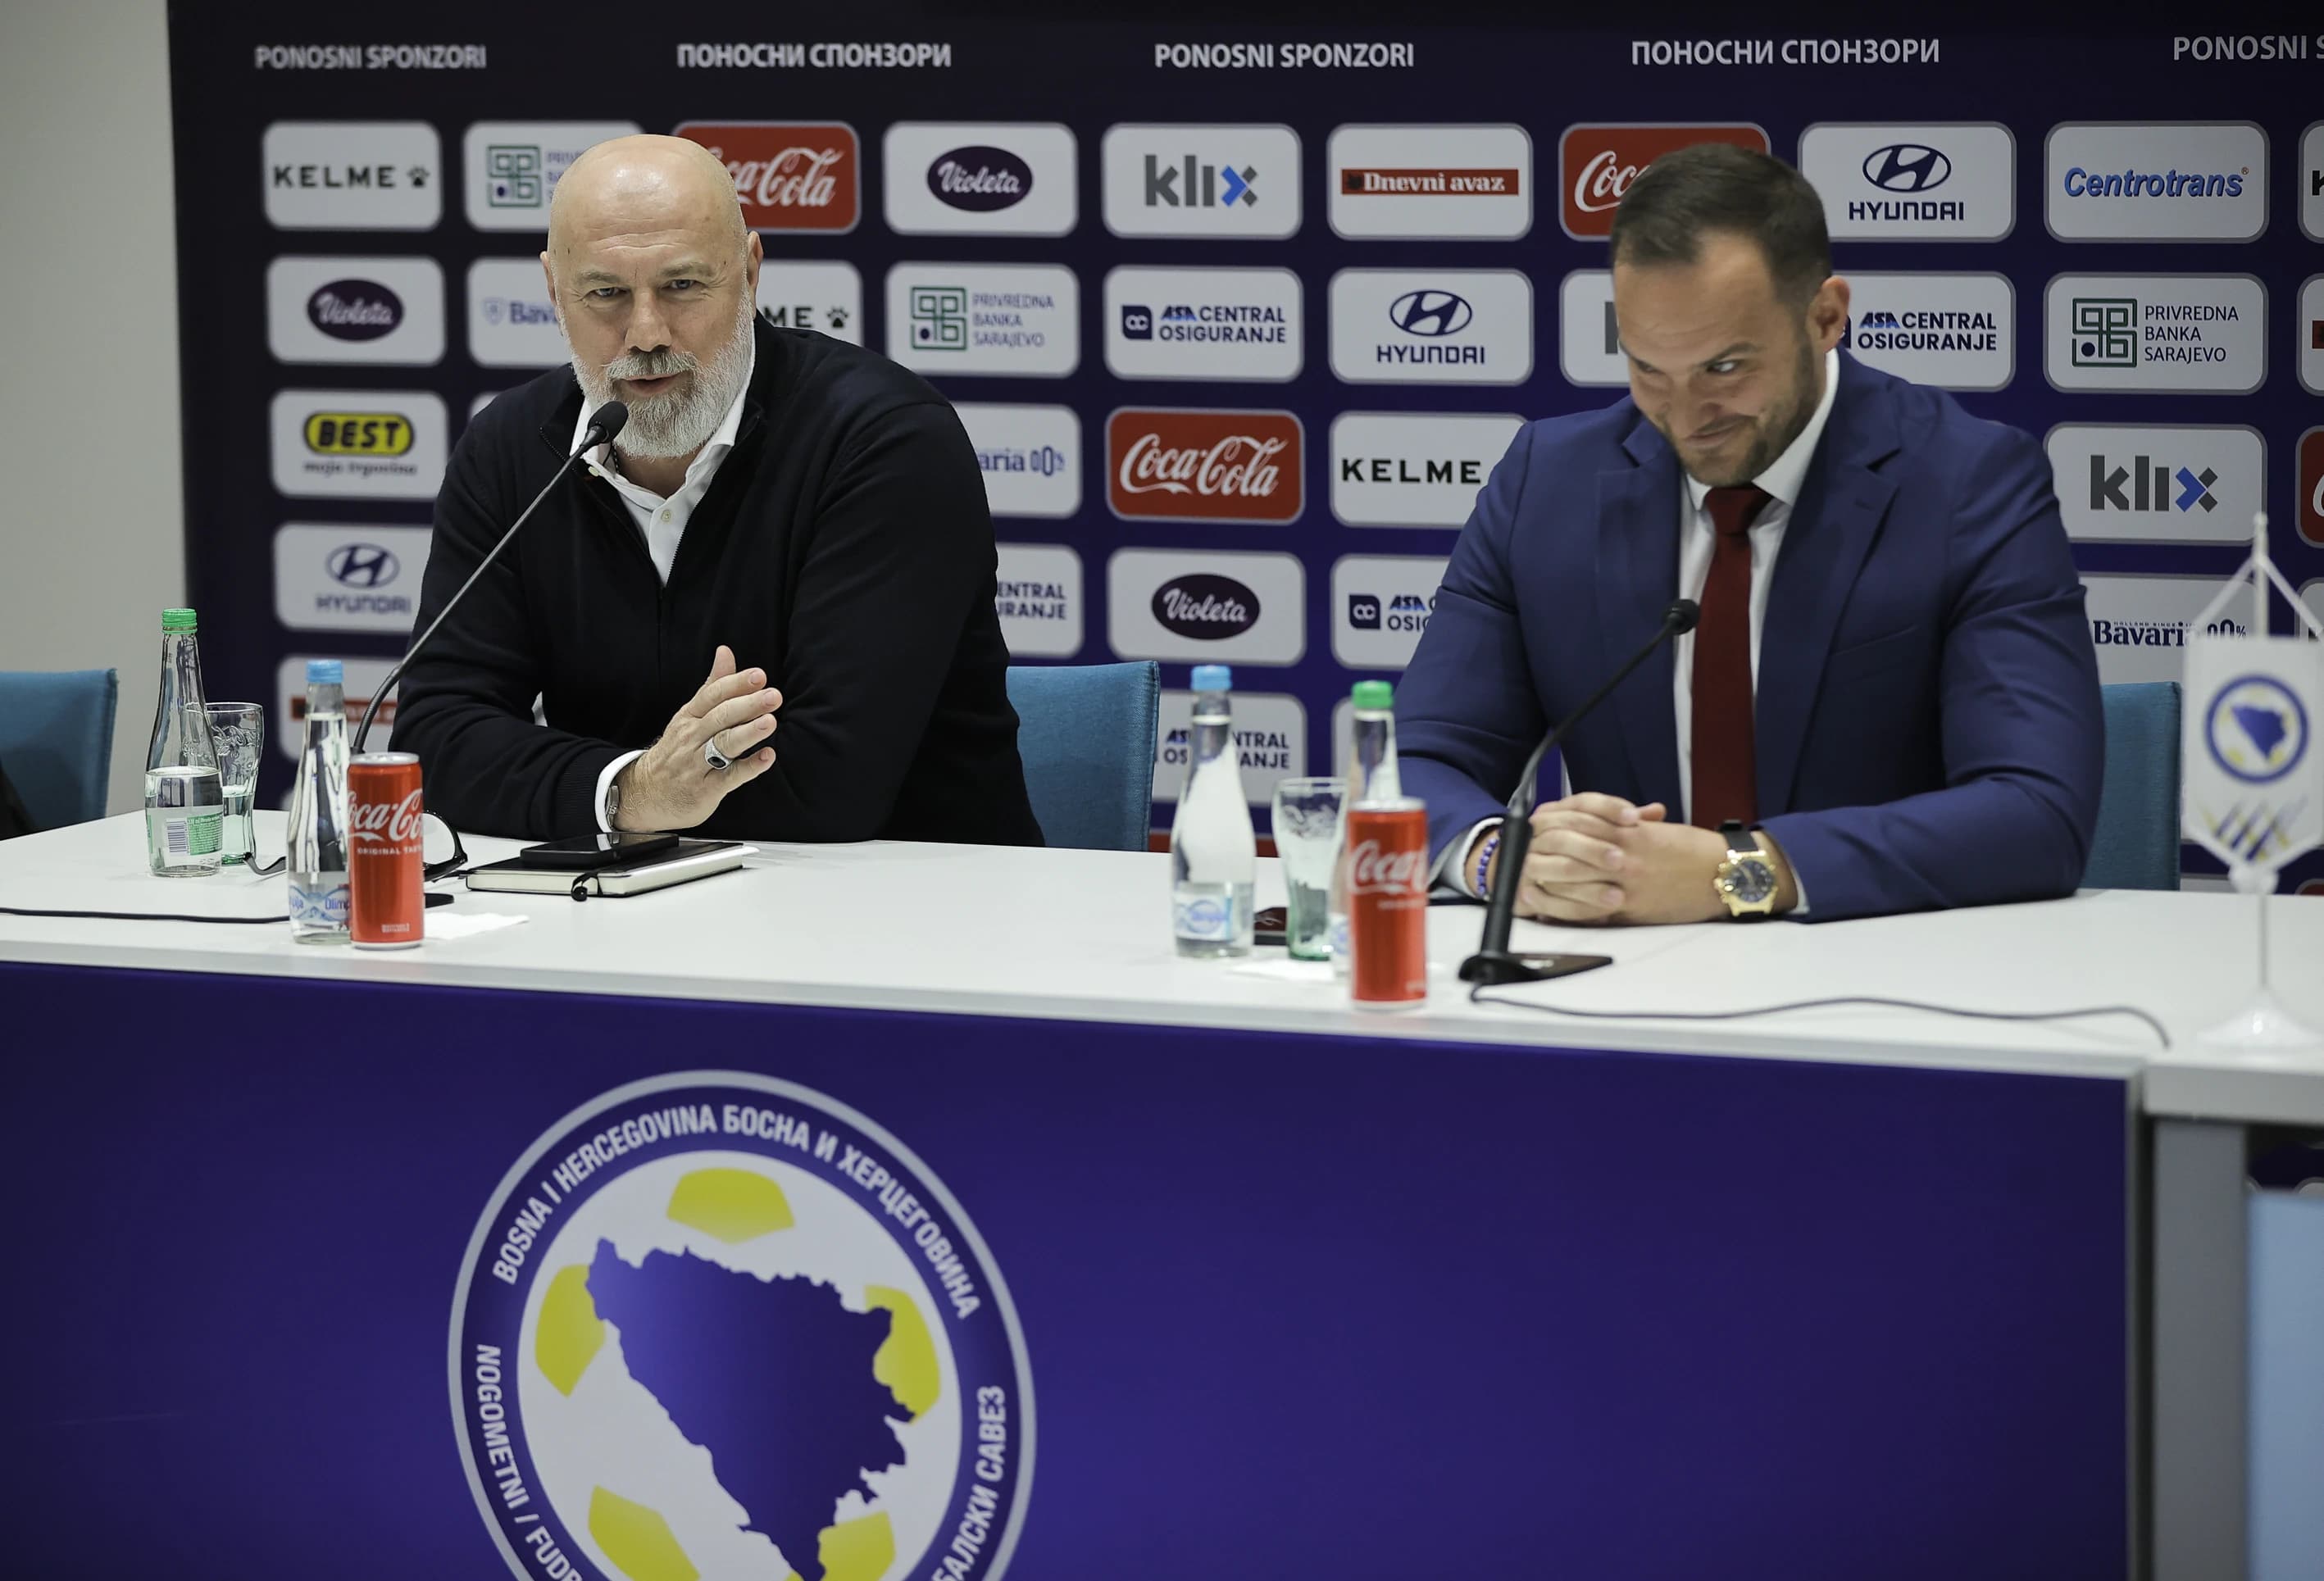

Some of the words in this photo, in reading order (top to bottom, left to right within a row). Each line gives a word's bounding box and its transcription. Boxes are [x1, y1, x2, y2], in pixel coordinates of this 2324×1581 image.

[255, 45, 362, 69] PONOSNI
[366, 44, 487, 69] SPONZORI
[677, 43, 805, 68] ПОНОСНИ
[809, 43, 952, 68] СПОНЗОРИ
[1154, 43, 1273, 67] PONOSNI
[1280, 43, 1415, 67] SPONZORI
[1632, 40, 1773, 65] ПОНОСНИ
[1781, 39, 1940, 63] СПОНЗОРИ
[2173, 35, 2307, 61] PONOSNI
[274, 166, 397, 188] KELME
[937, 161, 1021, 193] Violeta
[1144, 155, 1258, 207] klix
[1363, 172, 1444, 192] Dnevni
[1449, 175, 1505, 192] avaz
[1849, 202, 1964, 220] HYUNDAI
[315, 292, 394, 325] Violeta
[973, 312, 1023, 327] BANKA
[1199, 306, 1285, 323] CENTRAL
[1858, 312, 1901, 329] ASA
[1902, 312, 1996, 329] CENTRAL
[2144, 306, 2239, 321] PRIVREDNA
[1160, 325, 1286, 343] OSIGURANJE
[1858, 333, 1996, 351] OSIGURANJE
[2144, 326, 2202, 342] BANKA
[1377, 345, 1485, 364] HYUNDAI
[2144, 347, 2226, 364] SARAJEVO
[318, 419, 401, 448] BEST
[977, 447, 1026, 471] aria
[1120, 433, 1288, 497] Coca-Cola
[1342, 459, 1481, 484] KELME
[2090, 455, 2218, 513] klix
[316, 593, 410, 613] HYUNDAI
[998, 582, 1066, 600] ENTRAL
[1163, 588, 1246, 622] Violeta
[2093, 620, 2187, 647] Bavari
[493, 1197, 553, 1285] BOSNA
[541, 1181, 562, 1205] I
[553, 1104, 718, 1193] HERCEGOVINA
[723, 1105, 810, 1152] БОСНА
[815, 1130, 839, 1162] И
[837, 1145, 981, 1320] ХЕРЦЕГОВИНА
[476, 1344, 530, 1510] NOGOMETNI
[975, 1385, 1007, 1483] САВЕЗ
